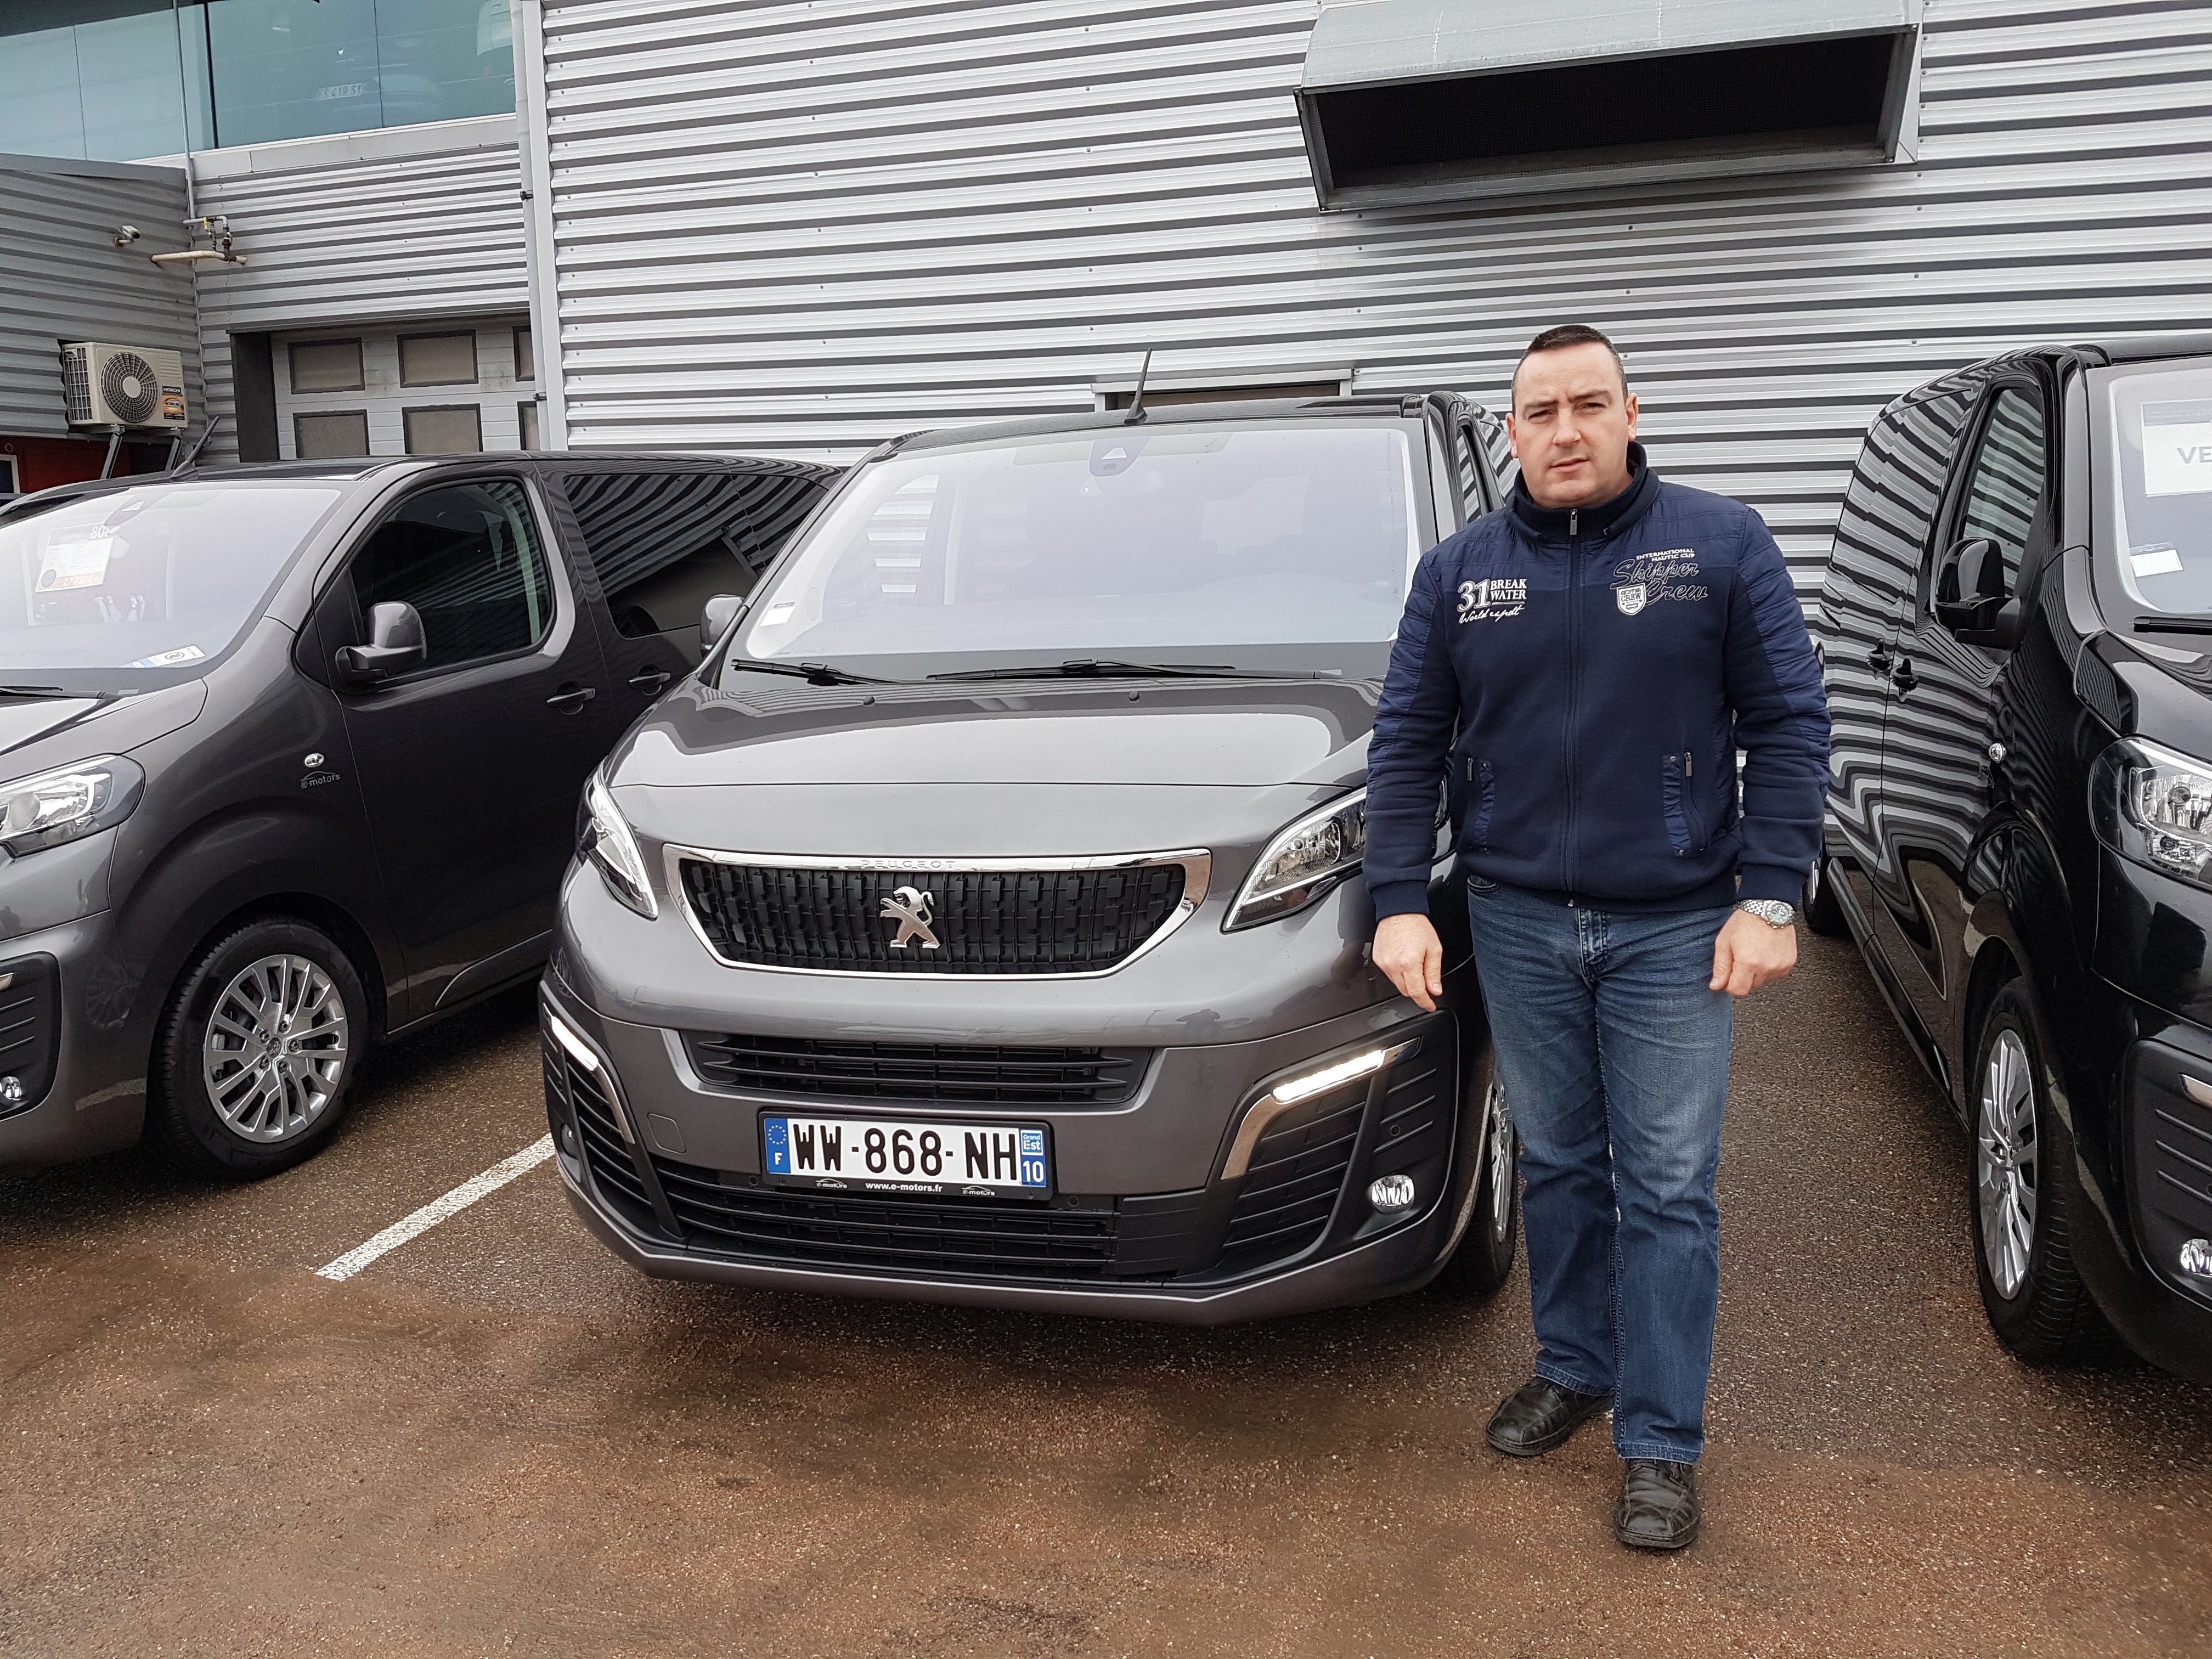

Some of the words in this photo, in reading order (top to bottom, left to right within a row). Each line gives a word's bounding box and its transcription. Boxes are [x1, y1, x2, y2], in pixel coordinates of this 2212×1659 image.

[1637, 549, 1695, 560] INTERNATIONAL
[1651, 554, 1679, 562] NAUTIC
[1610, 558, 1700, 590] Skipper
[1490, 579, 1527, 590] BREAK
[1457, 579, 1491, 612] 31
[1490, 589, 1527, 601] WATER
[1621, 593, 1642, 602] CREW
[1644, 578, 1708, 607] Crew
[861, 860, 955, 869] PEUGEOT
[1023, 1140, 1041, 1150] Est
[775, 1152, 783, 1165] F
[1023, 1160, 1044, 1183] 10
[865, 1182, 943, 1193] www.e-motors.fr
